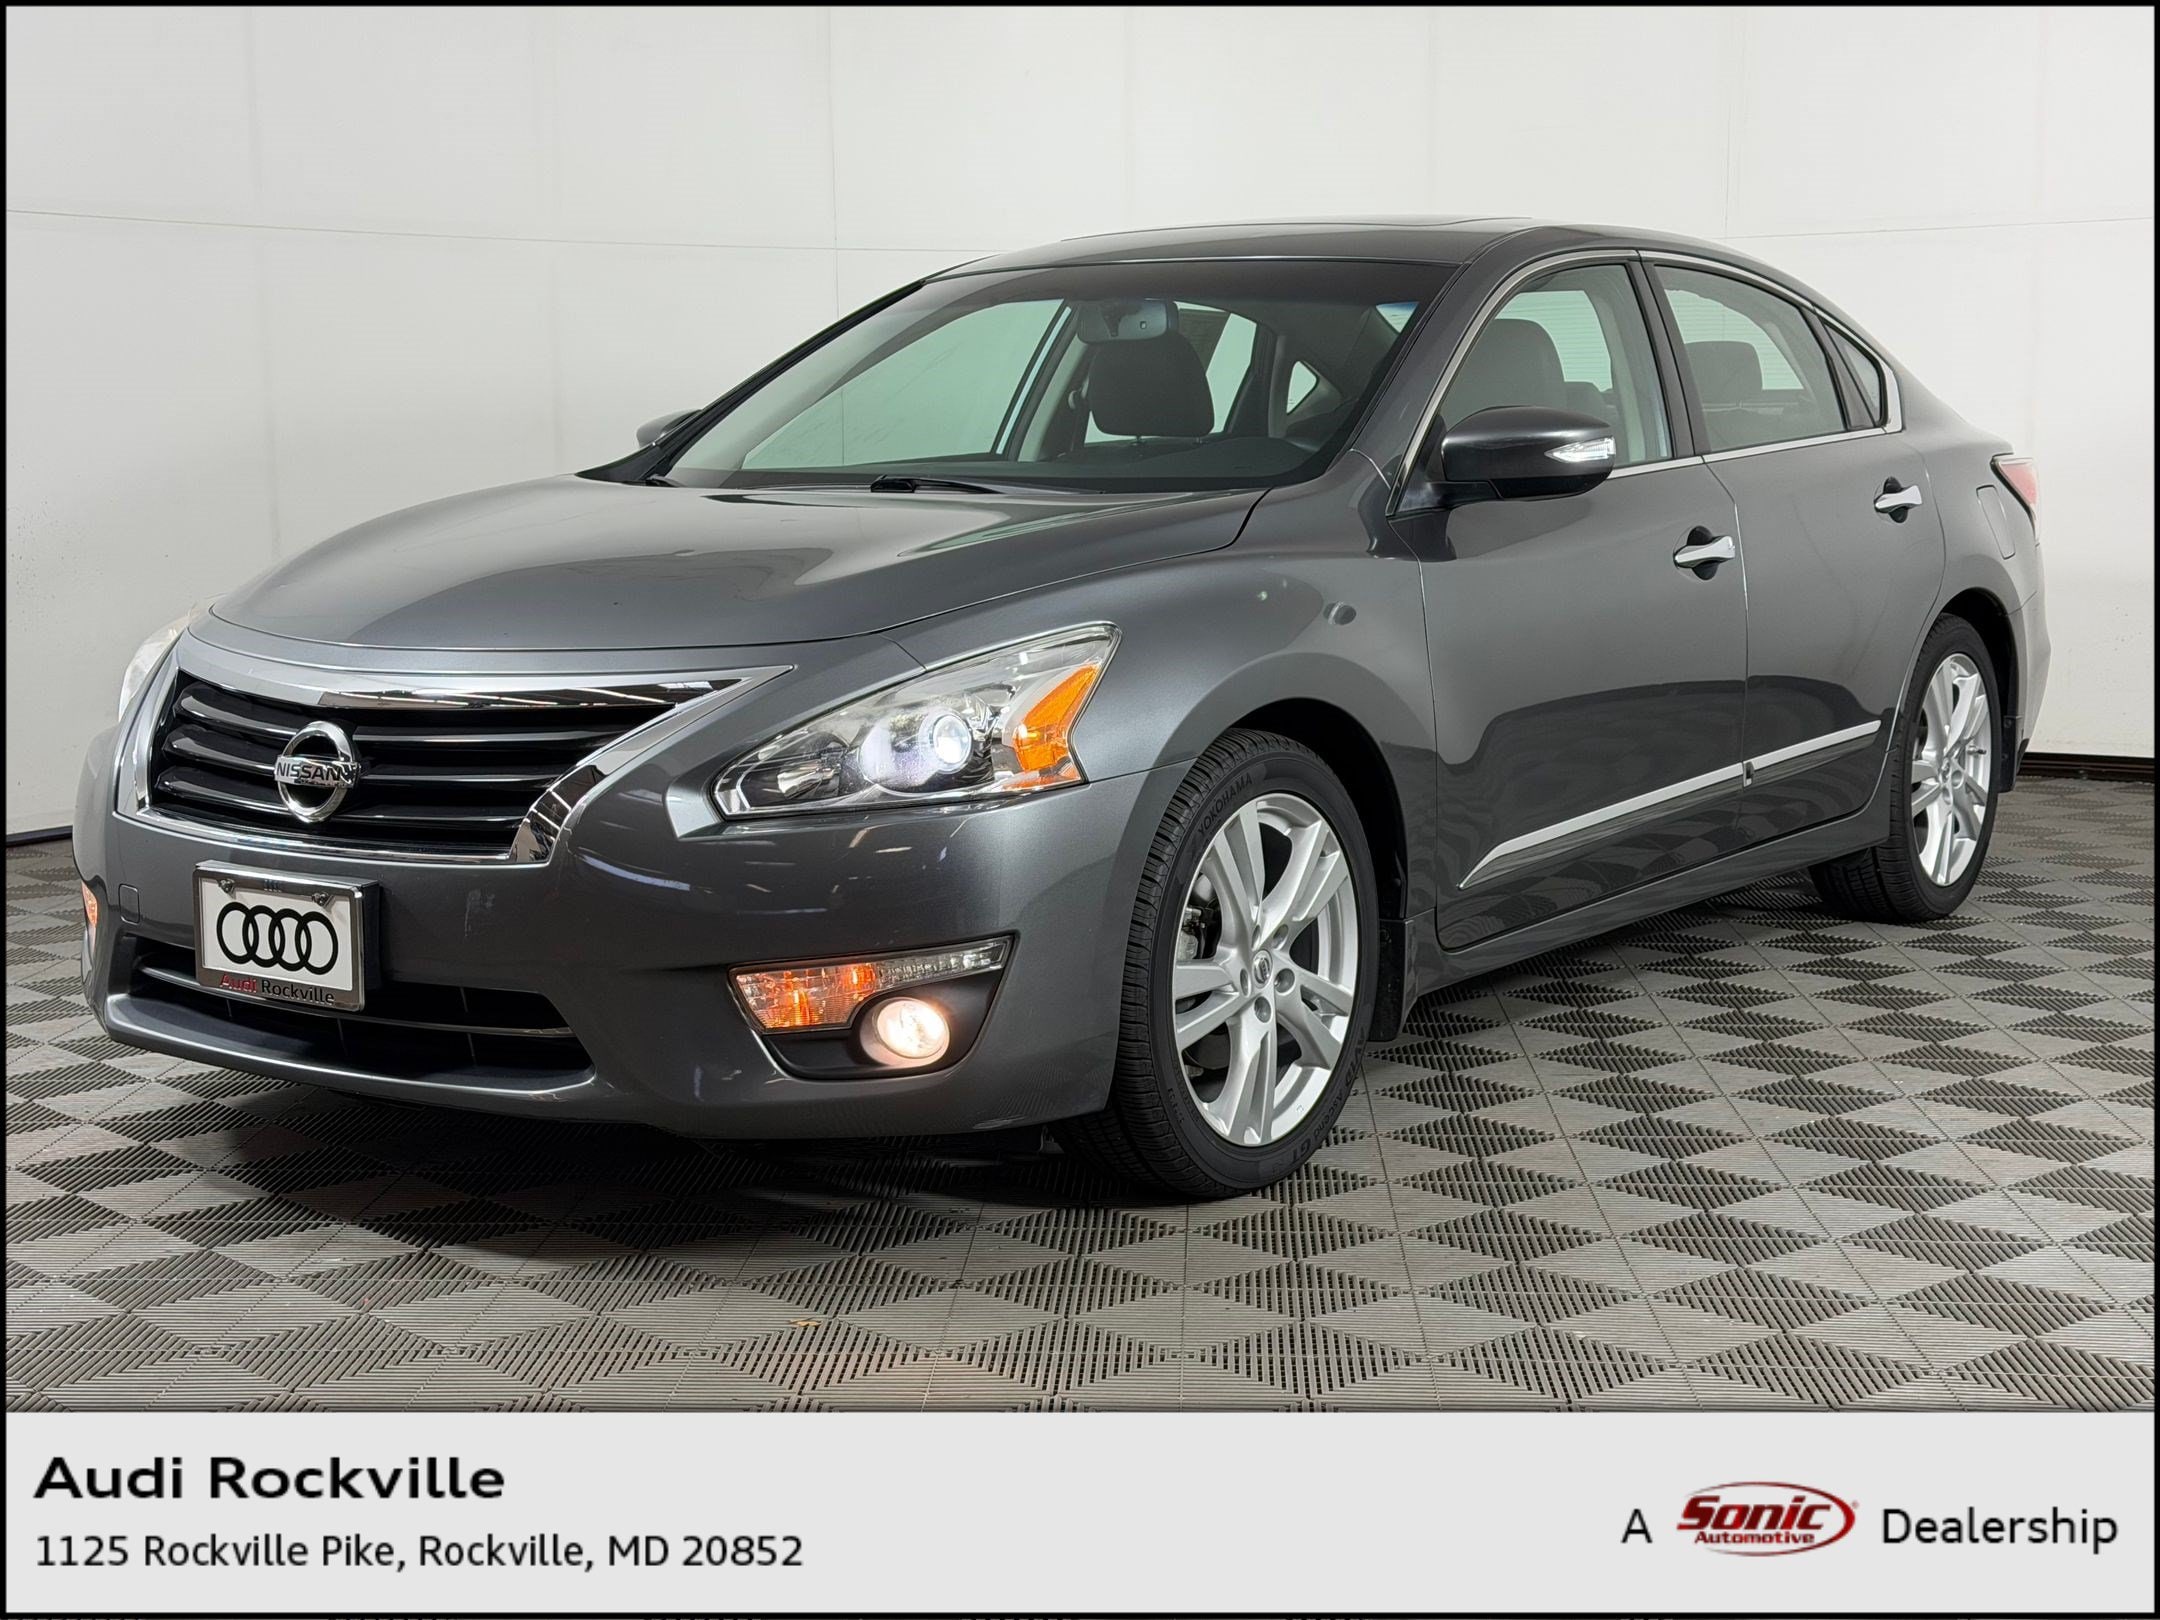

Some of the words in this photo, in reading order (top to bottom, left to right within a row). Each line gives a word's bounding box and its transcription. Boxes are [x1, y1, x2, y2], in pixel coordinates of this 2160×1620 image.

[277, 761, 341, 781] NISSAN
[1198, 772, 1252, 835] YOKOHAMA
[220, 972, 257, 994] Audi
[261, 979, 335, 1005] Rockville
